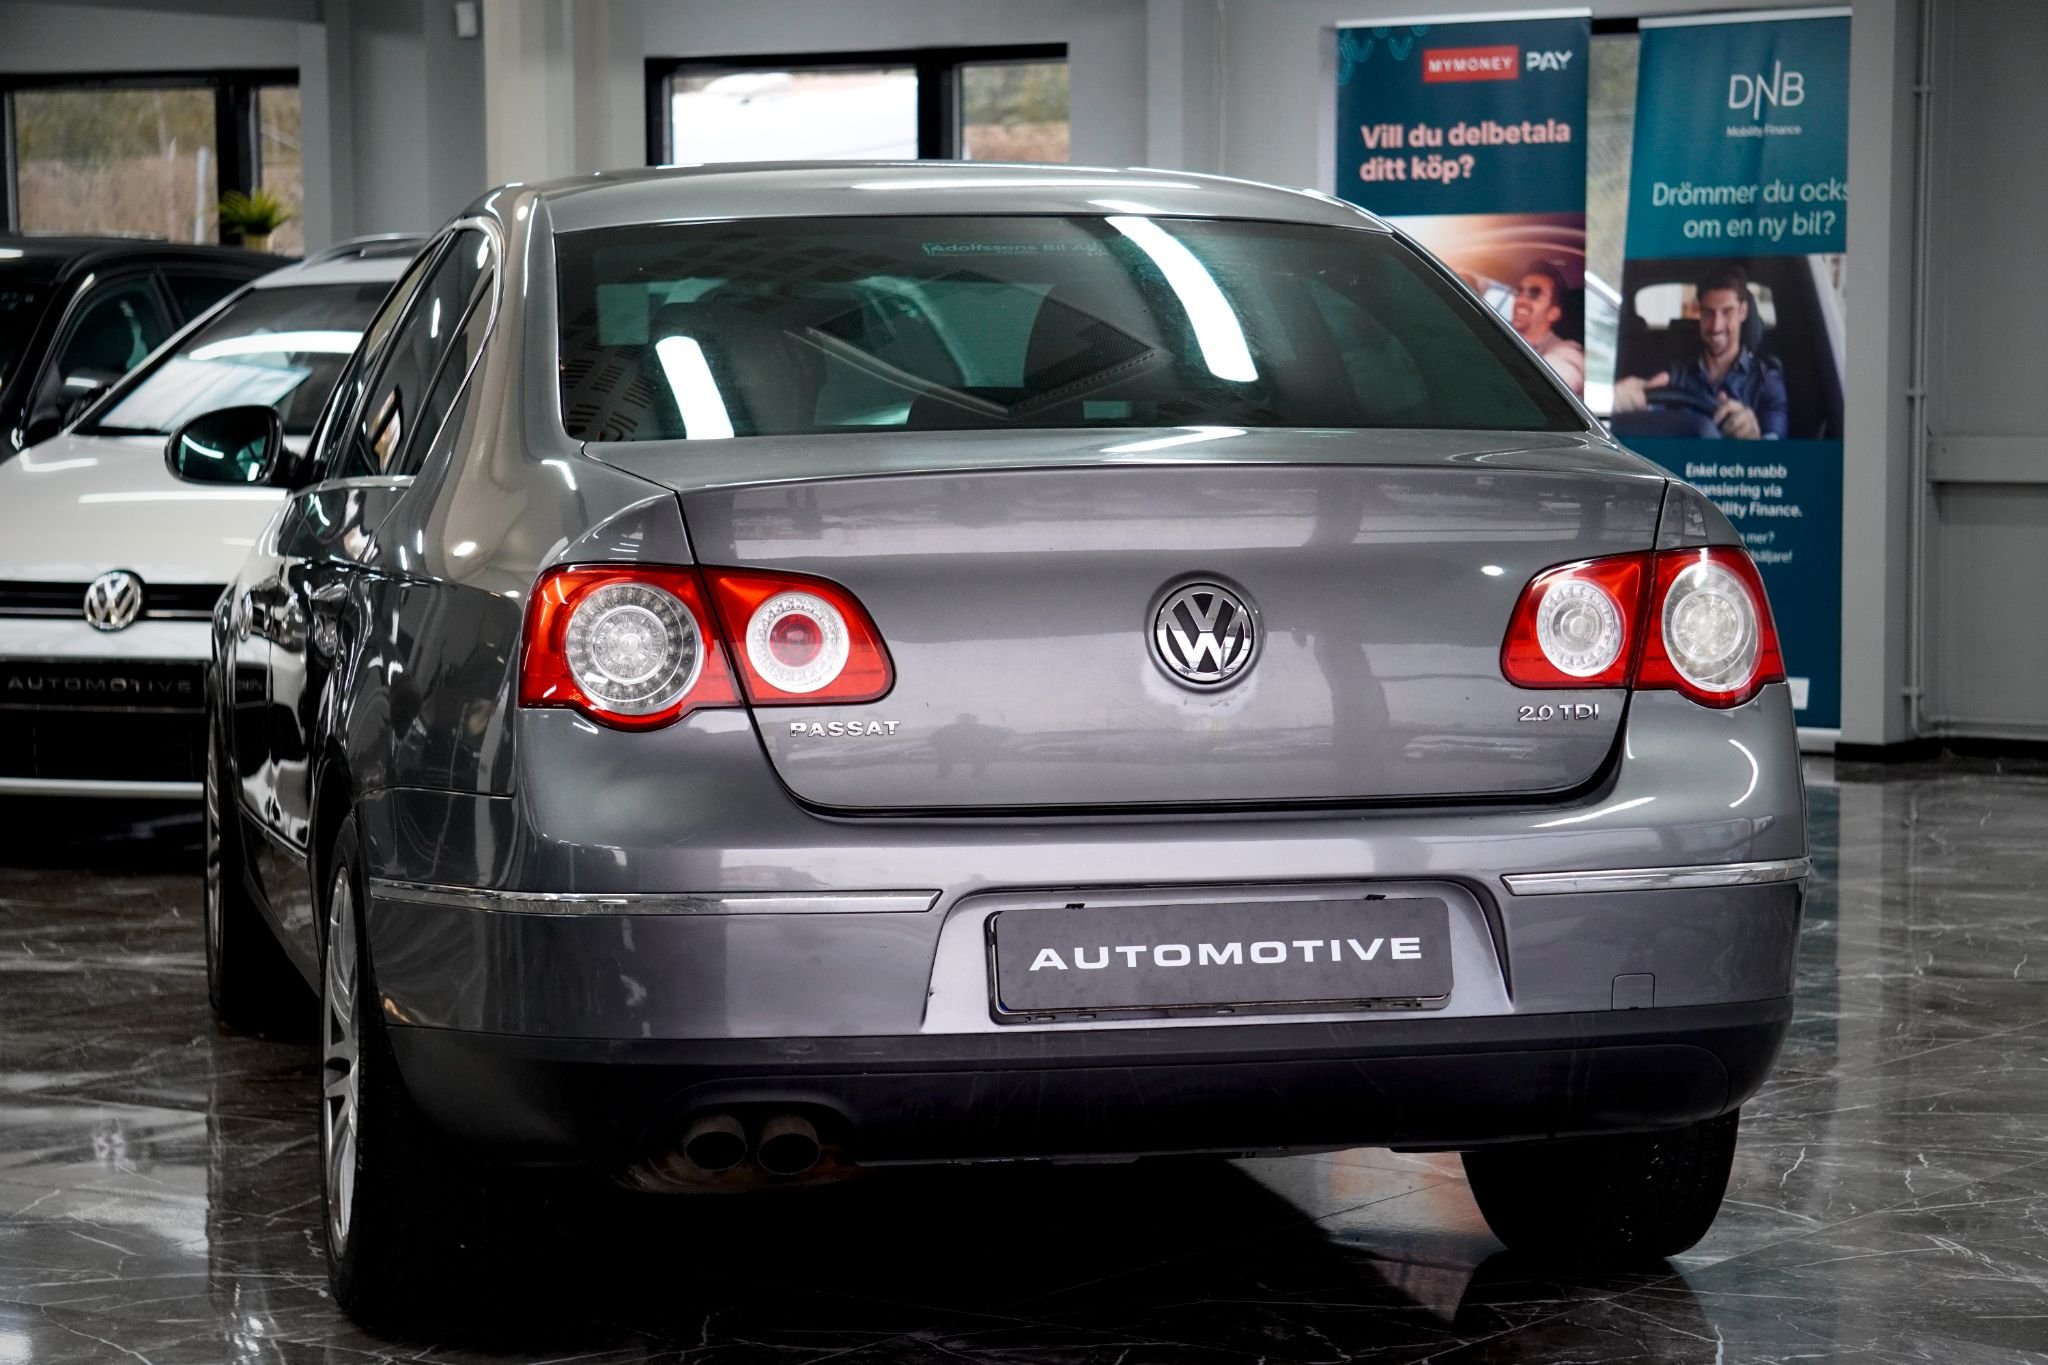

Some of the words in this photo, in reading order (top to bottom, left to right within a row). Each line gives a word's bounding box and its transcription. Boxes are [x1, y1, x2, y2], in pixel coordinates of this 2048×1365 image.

[1428, 56, 1513, 73] MYMONEY
[1526, 50, 1573, 71] PAY
[1728, 59, 1805, 120] DNB
[1361, 124, 1403, 149] Vill
[1408, 123, 1442, 147] du
[1448, 119, 1572, 146] delbetala
[1726, 126, 1763, 138] Mobility
[1764, 123, 1802, 136] Finance
[1360, 157, 1406, 181] ditt
[1411, 154, 1475, 184] köp?
[1652, 181, 1758, 207] Drömmer
[1763, 178, 1794, 204] du
[1800, 176, 1849, 202] ocks
[1683, 218, 1721, 239] om
[1726, 217, 1753, 238] en
[1758, 216, 1787, 242] ny
[1792, 210, 1836, 236] bil?
[1685, 462, 1718, 478] Enkel
[1719, 462, 1745, 478] och
[1747, 463, 1787, 479] snabb
[1689, 481, 1761, 500] ansiering
[1763, 482, 1782, 498] via
[8, 676, 192, 693] AUTOMOTIVE
[1518, 704, 1553, 721] 2.0
[1558, 703, 1599, 720] TDI
[790, 720, 900, 737] PASSAT
[1029, 937, 1422, 971] AUTOMOTIVE
